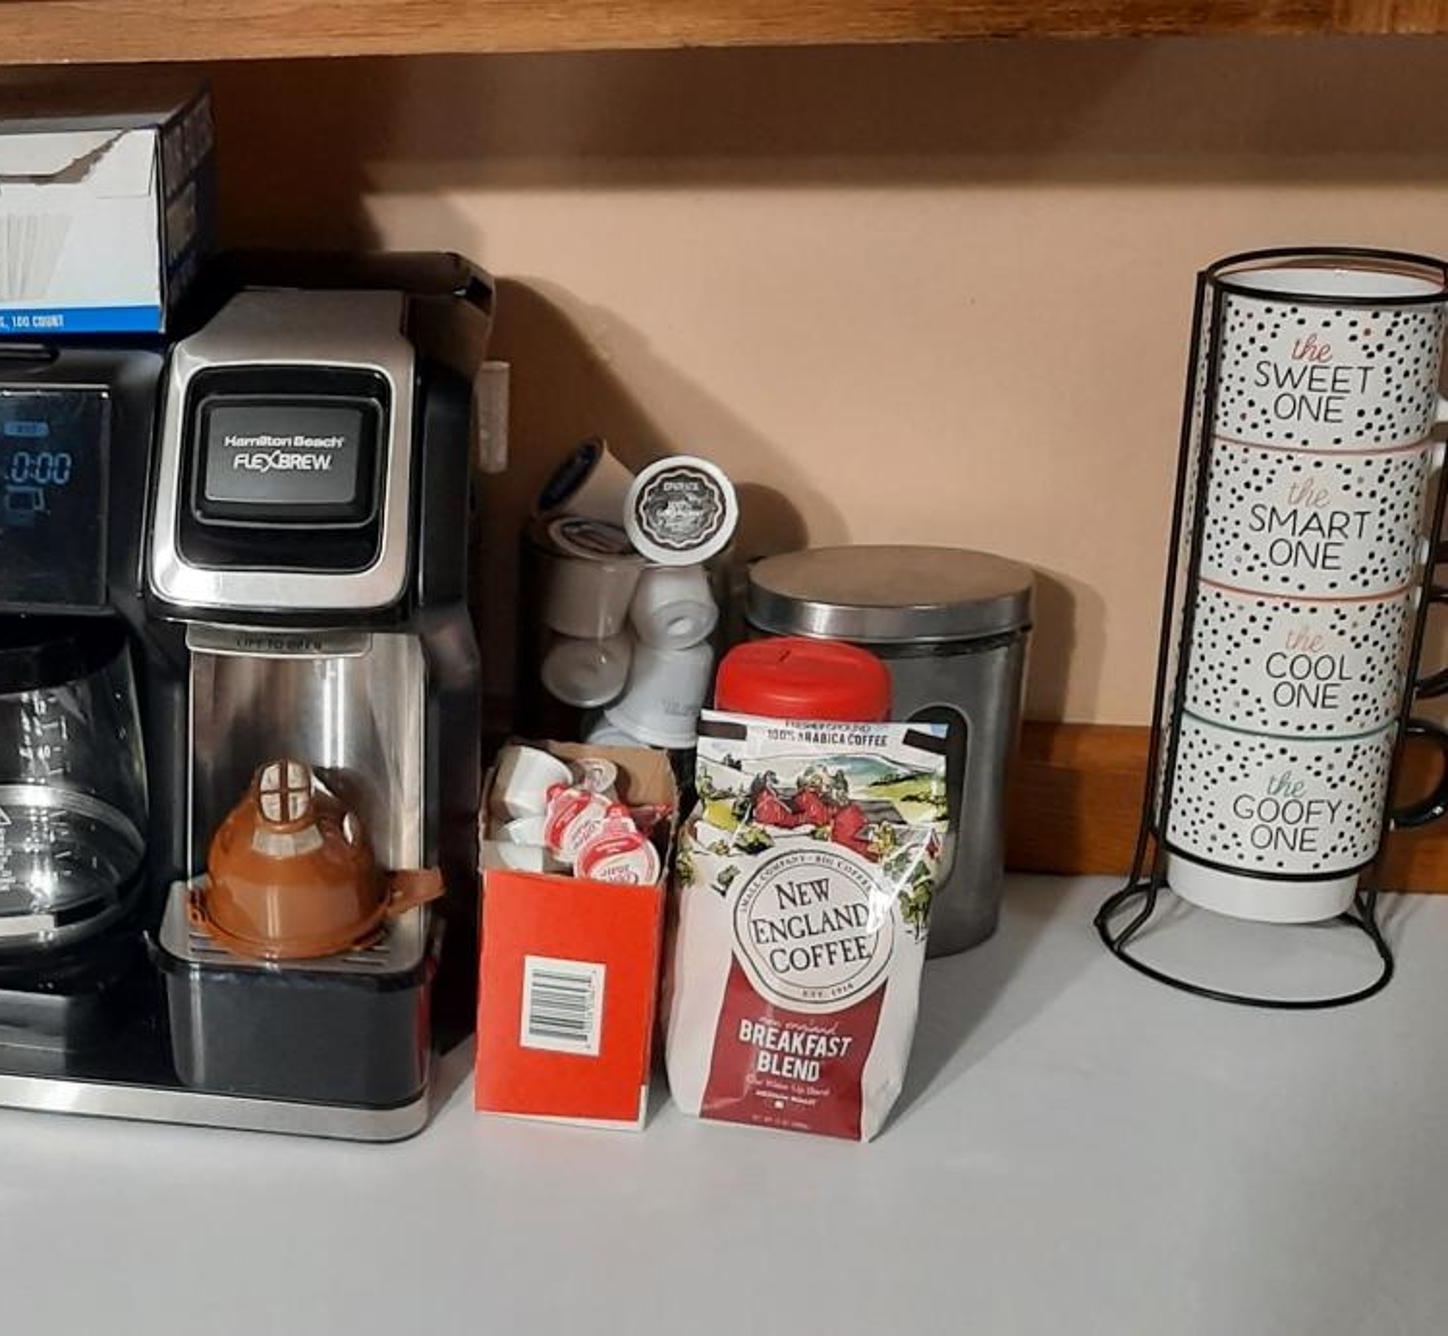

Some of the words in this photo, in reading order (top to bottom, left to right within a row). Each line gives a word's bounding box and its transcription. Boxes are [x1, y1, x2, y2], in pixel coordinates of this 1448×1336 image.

[12, 316, 30, 328] 100
[32, 314, 65, 327] COUNT
[1292, 333, 1332, 363] the
[1254, 360, 1375, 394] SWEET
[1274, 392, 1346, 423] ONE
[224, 435, 292, 447] Hamilton
[294, 435, 342, 448] Beach
[1288, 477, 1331, 509] the
[1249, 503, 1371, 539] SMART
[1269, 538, 1344, 570] ONE
[1285, 626, 1323, 653] the
[1266, 652, 1353, 681] COOL
[1273, 681, 1342, 709] ONE
[767, 729, 795, 741] 100%
[798, 731, 846, 745] ARABICA
[847, 733, 888, 746] COFFEE
[1267, 770, 1307, 798] the
[1233, 794, 1343, 825] GOOFY
[1251, 824, 1320, 853] ONE
[775, 878, 830, 910] NEW
[752, 903, 870, 944] ENGLAND
[769, 935, 872, 974] COFFEE
[739, 1018, 852, 1057] BREAKFAST
[756, 1050, 820, 1082] BLEND
